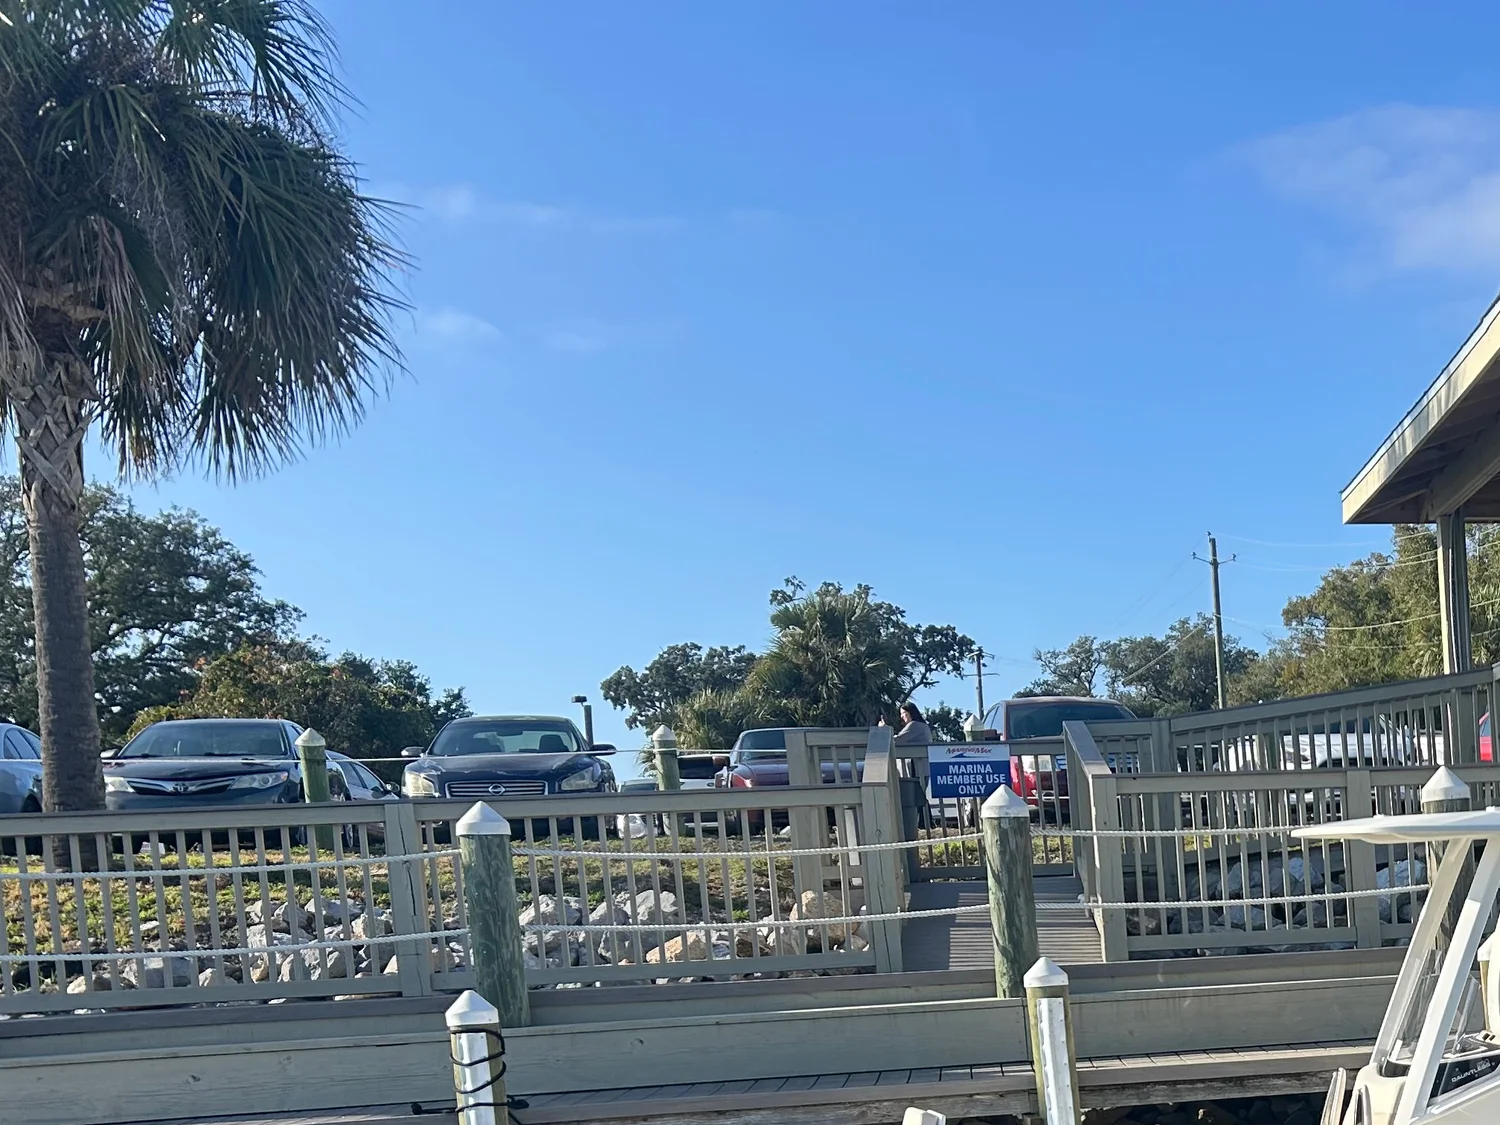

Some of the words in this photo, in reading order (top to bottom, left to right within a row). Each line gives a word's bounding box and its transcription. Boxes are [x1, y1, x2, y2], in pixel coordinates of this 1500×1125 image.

[949, 764, 993, 774] MARINA
[937, 775, 983, 785] MEMBER
[986, 774, 1006, 783] USE
[958, 785, 986, 794] ONLY
